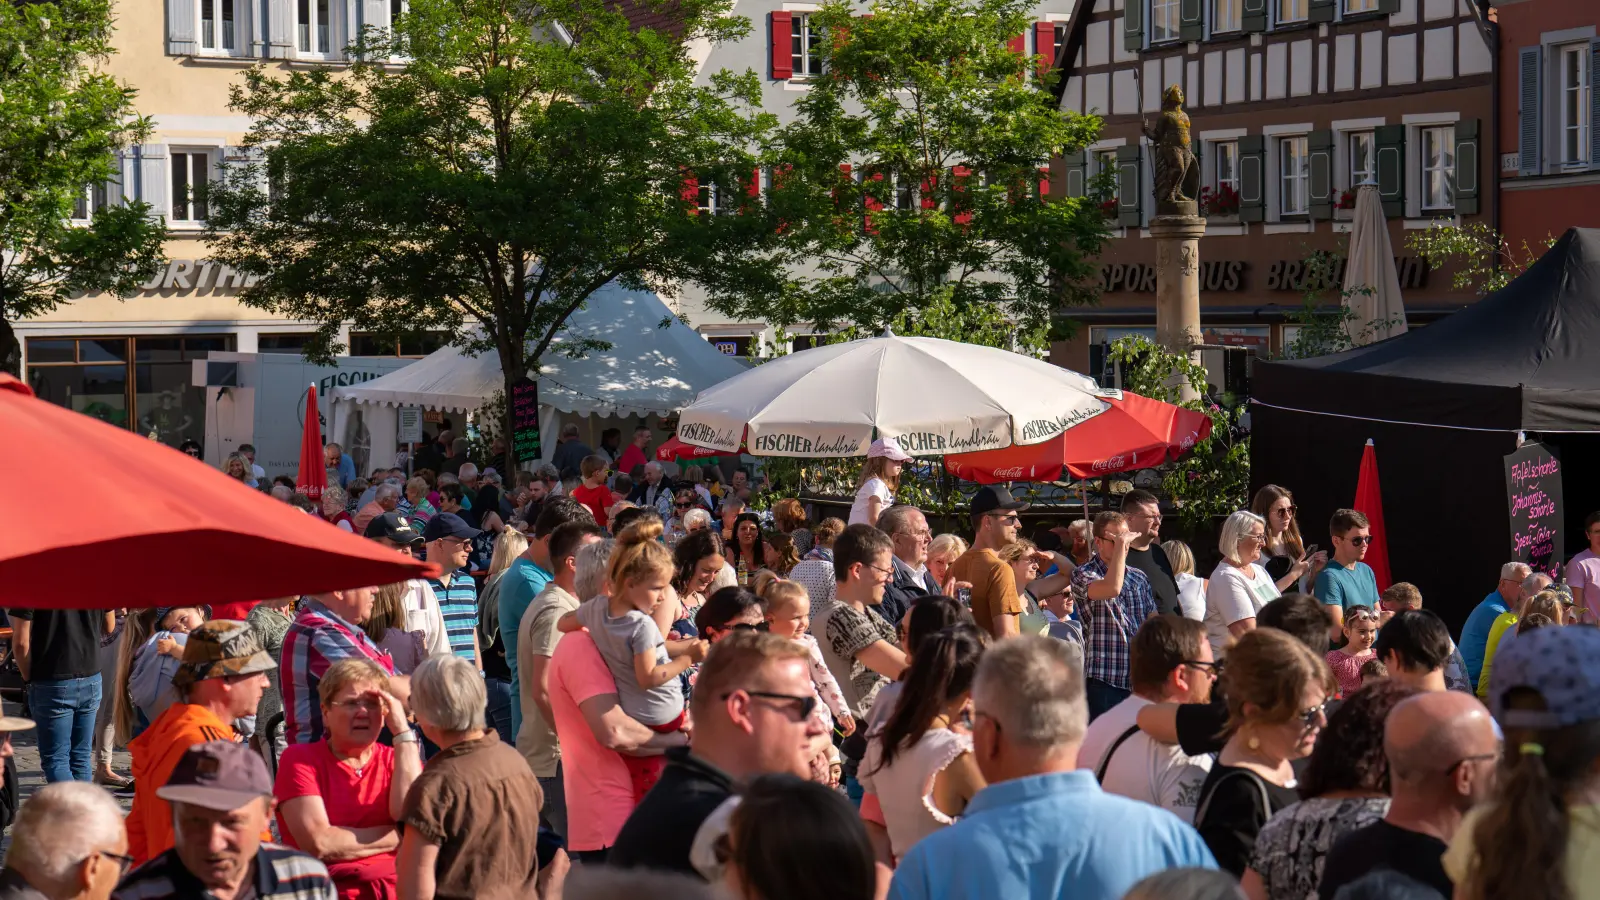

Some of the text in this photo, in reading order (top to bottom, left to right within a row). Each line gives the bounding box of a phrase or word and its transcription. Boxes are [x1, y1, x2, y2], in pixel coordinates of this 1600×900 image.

[680, 422, 715, 443] FISCHER
[893, 430, 1001, 451] ISCHER landbräu
[1022, 419, 1060, 441] FISCHER
[755, 433, 812, 453] FISCHER
